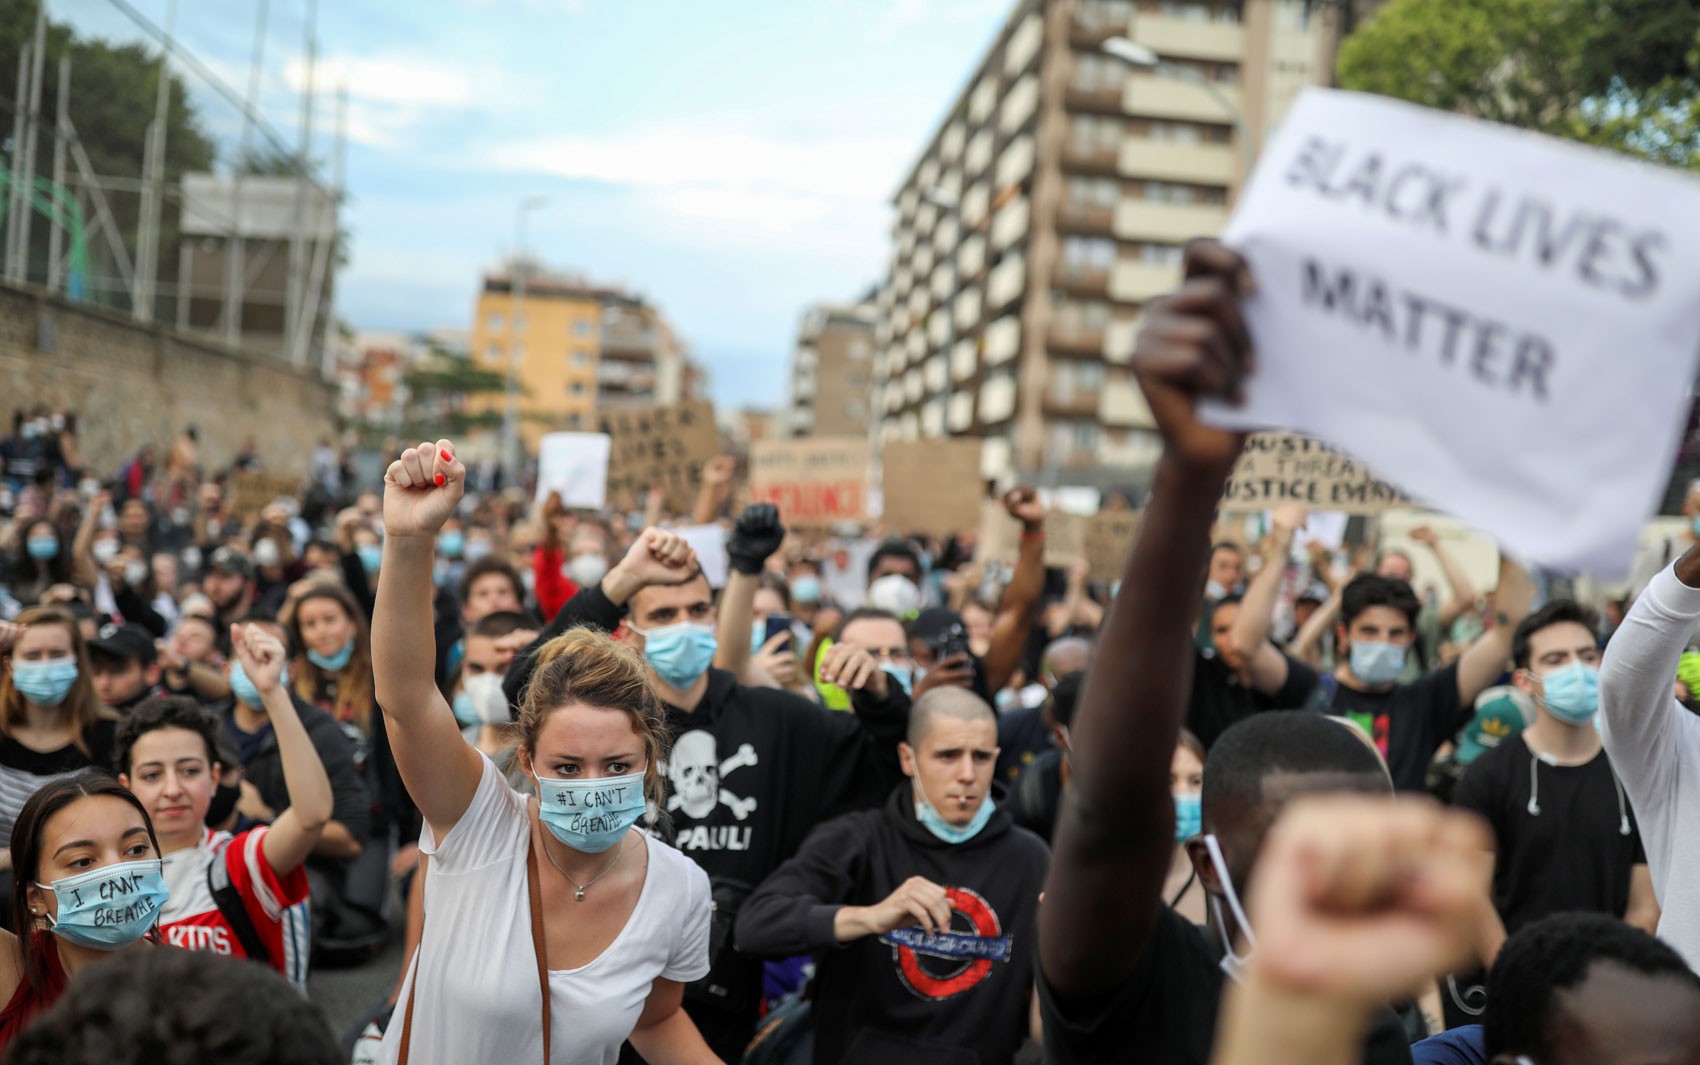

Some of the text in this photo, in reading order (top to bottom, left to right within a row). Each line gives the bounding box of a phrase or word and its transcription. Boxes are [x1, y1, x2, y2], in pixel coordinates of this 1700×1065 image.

[1285, 134, 1669, 302] BLACK LIVES
[1300, 256, 1558, 402] MATTER
[1224, 478, 1317, 501] USTICE
[556, 787, 627, 808] #I CAN'T
[571, 812, 622, 835] BREATHE
[675, 825, 753, 851] PAULI
[70, 888, 85, 908] I
[94, 896, 155, 928] BREATHE
[168, 924, 232, 956] KIDS
